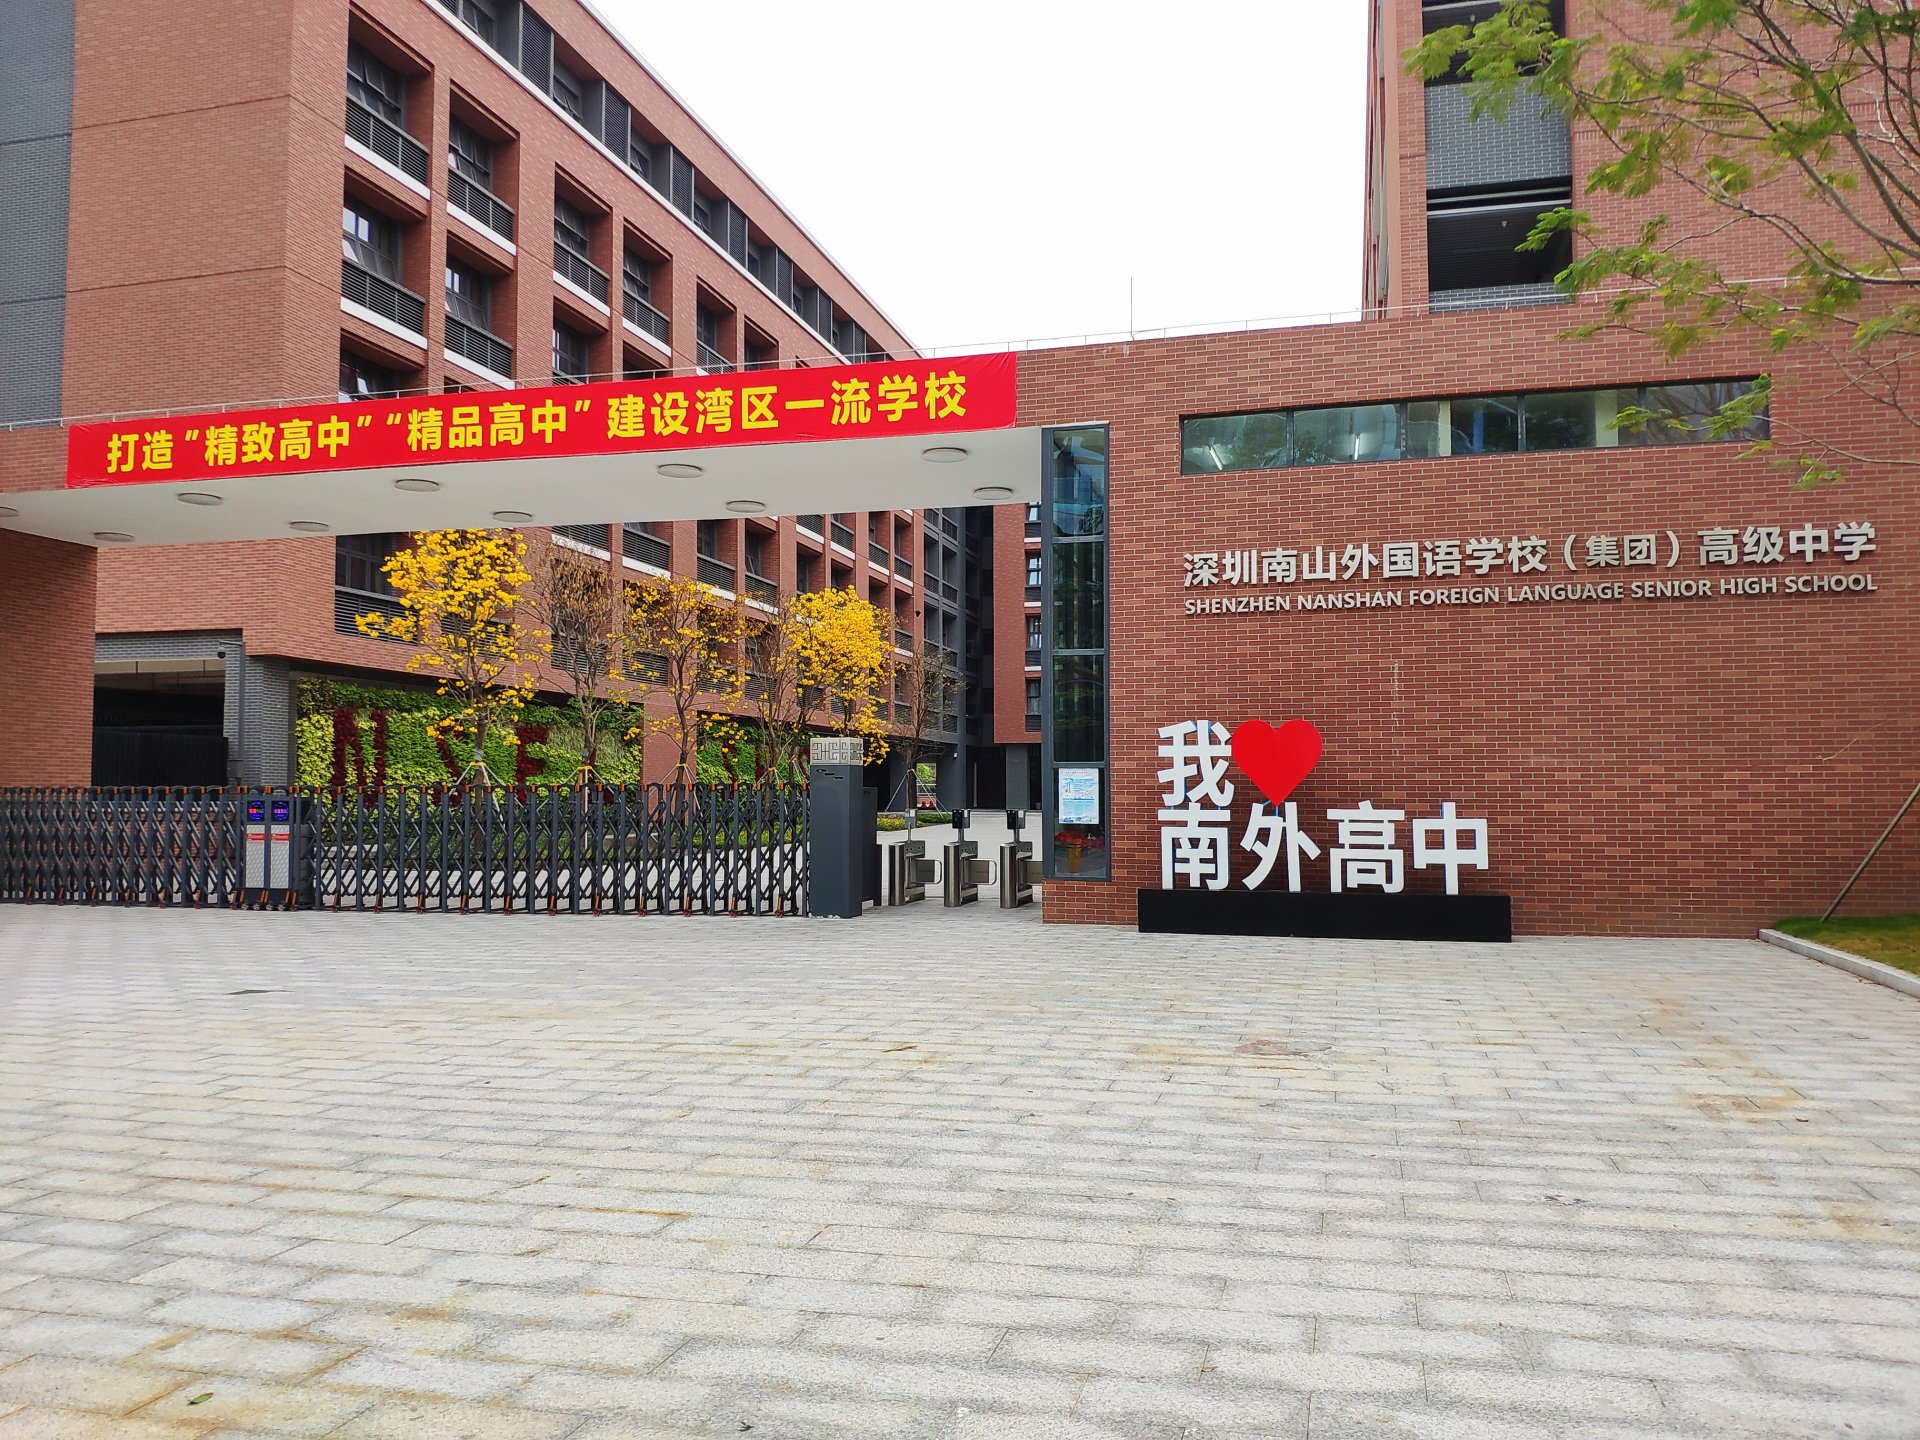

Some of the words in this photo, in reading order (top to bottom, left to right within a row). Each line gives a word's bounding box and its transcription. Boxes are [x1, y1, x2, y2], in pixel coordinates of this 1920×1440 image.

[1185, 595, 1291, 615] SHENZHEN
[1297, 590, 1402, 610] NANSHAN
[1409, 587, 1500, 606] FOREIGN
[1507, 582, 1625, 602] LANGUAGE
[1631, 578, 1713, 597] SENIOR
[1720, 577, 1778, 595] HIGH
[1785, 573, 1879, 594] SCHOOL
[1157, 719, 1235, 807] 我
[1157, 800, 1489, 896] 南外高中
